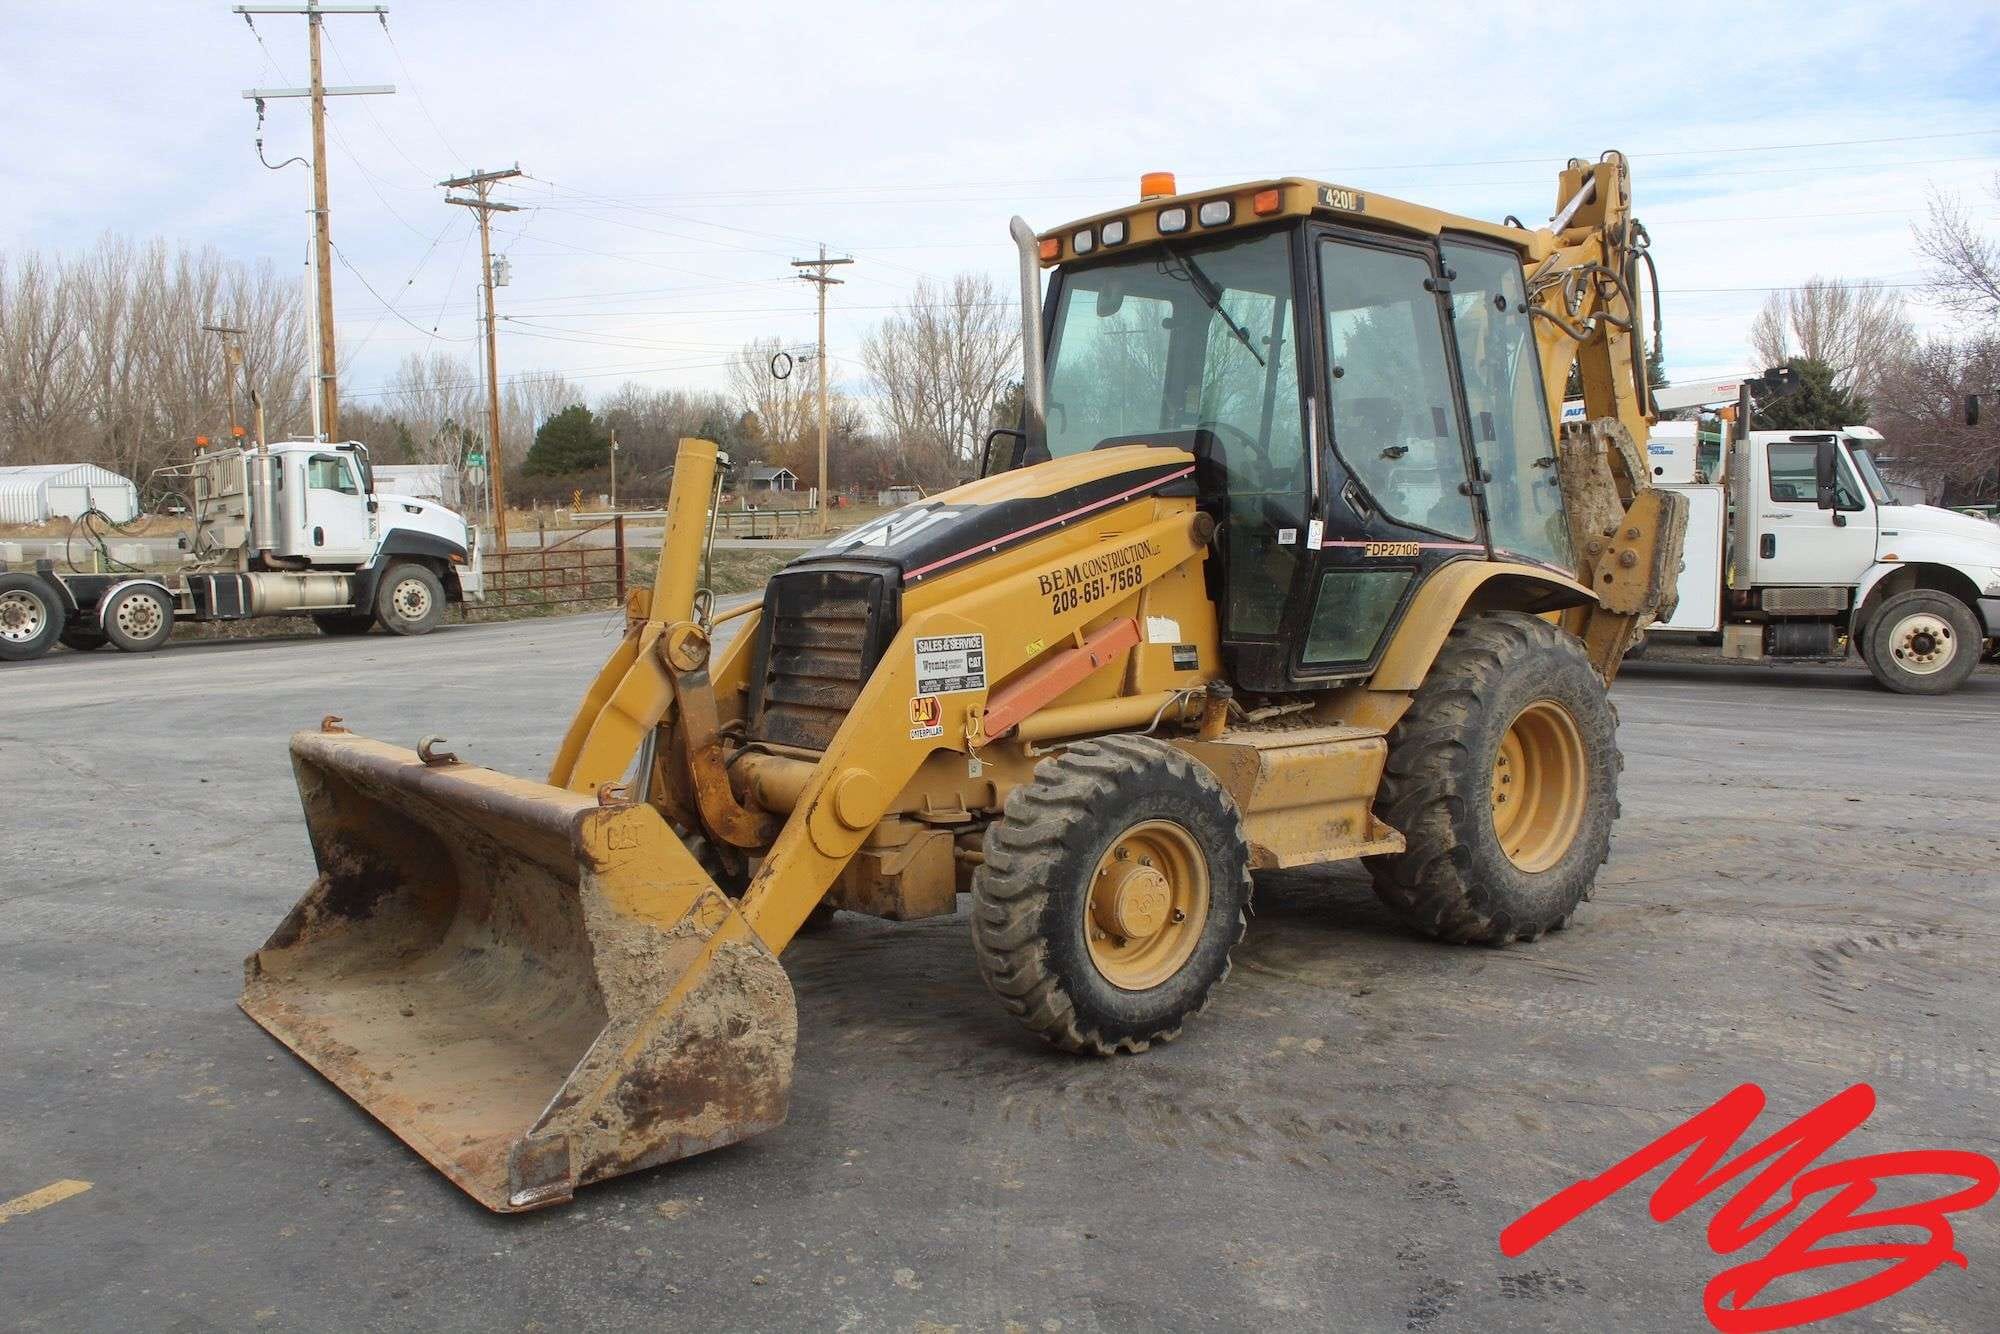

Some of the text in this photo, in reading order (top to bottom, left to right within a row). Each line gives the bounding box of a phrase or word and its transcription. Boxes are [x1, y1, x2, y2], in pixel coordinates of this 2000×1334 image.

[1365, 543, 1418, 556] FDP27106
[1037, 564, 1083, 596] BEM
[1081, 539, 1151, 579] CONSTRUCTION
[1052, 564, 1143, 615] 208-651-7568
[918, 639, 943, 653] SALES
[950, 636, 982, 650] SERVICE
[968, 656, 982, 669] CAT
[911, 698, 934, 722] CAT
